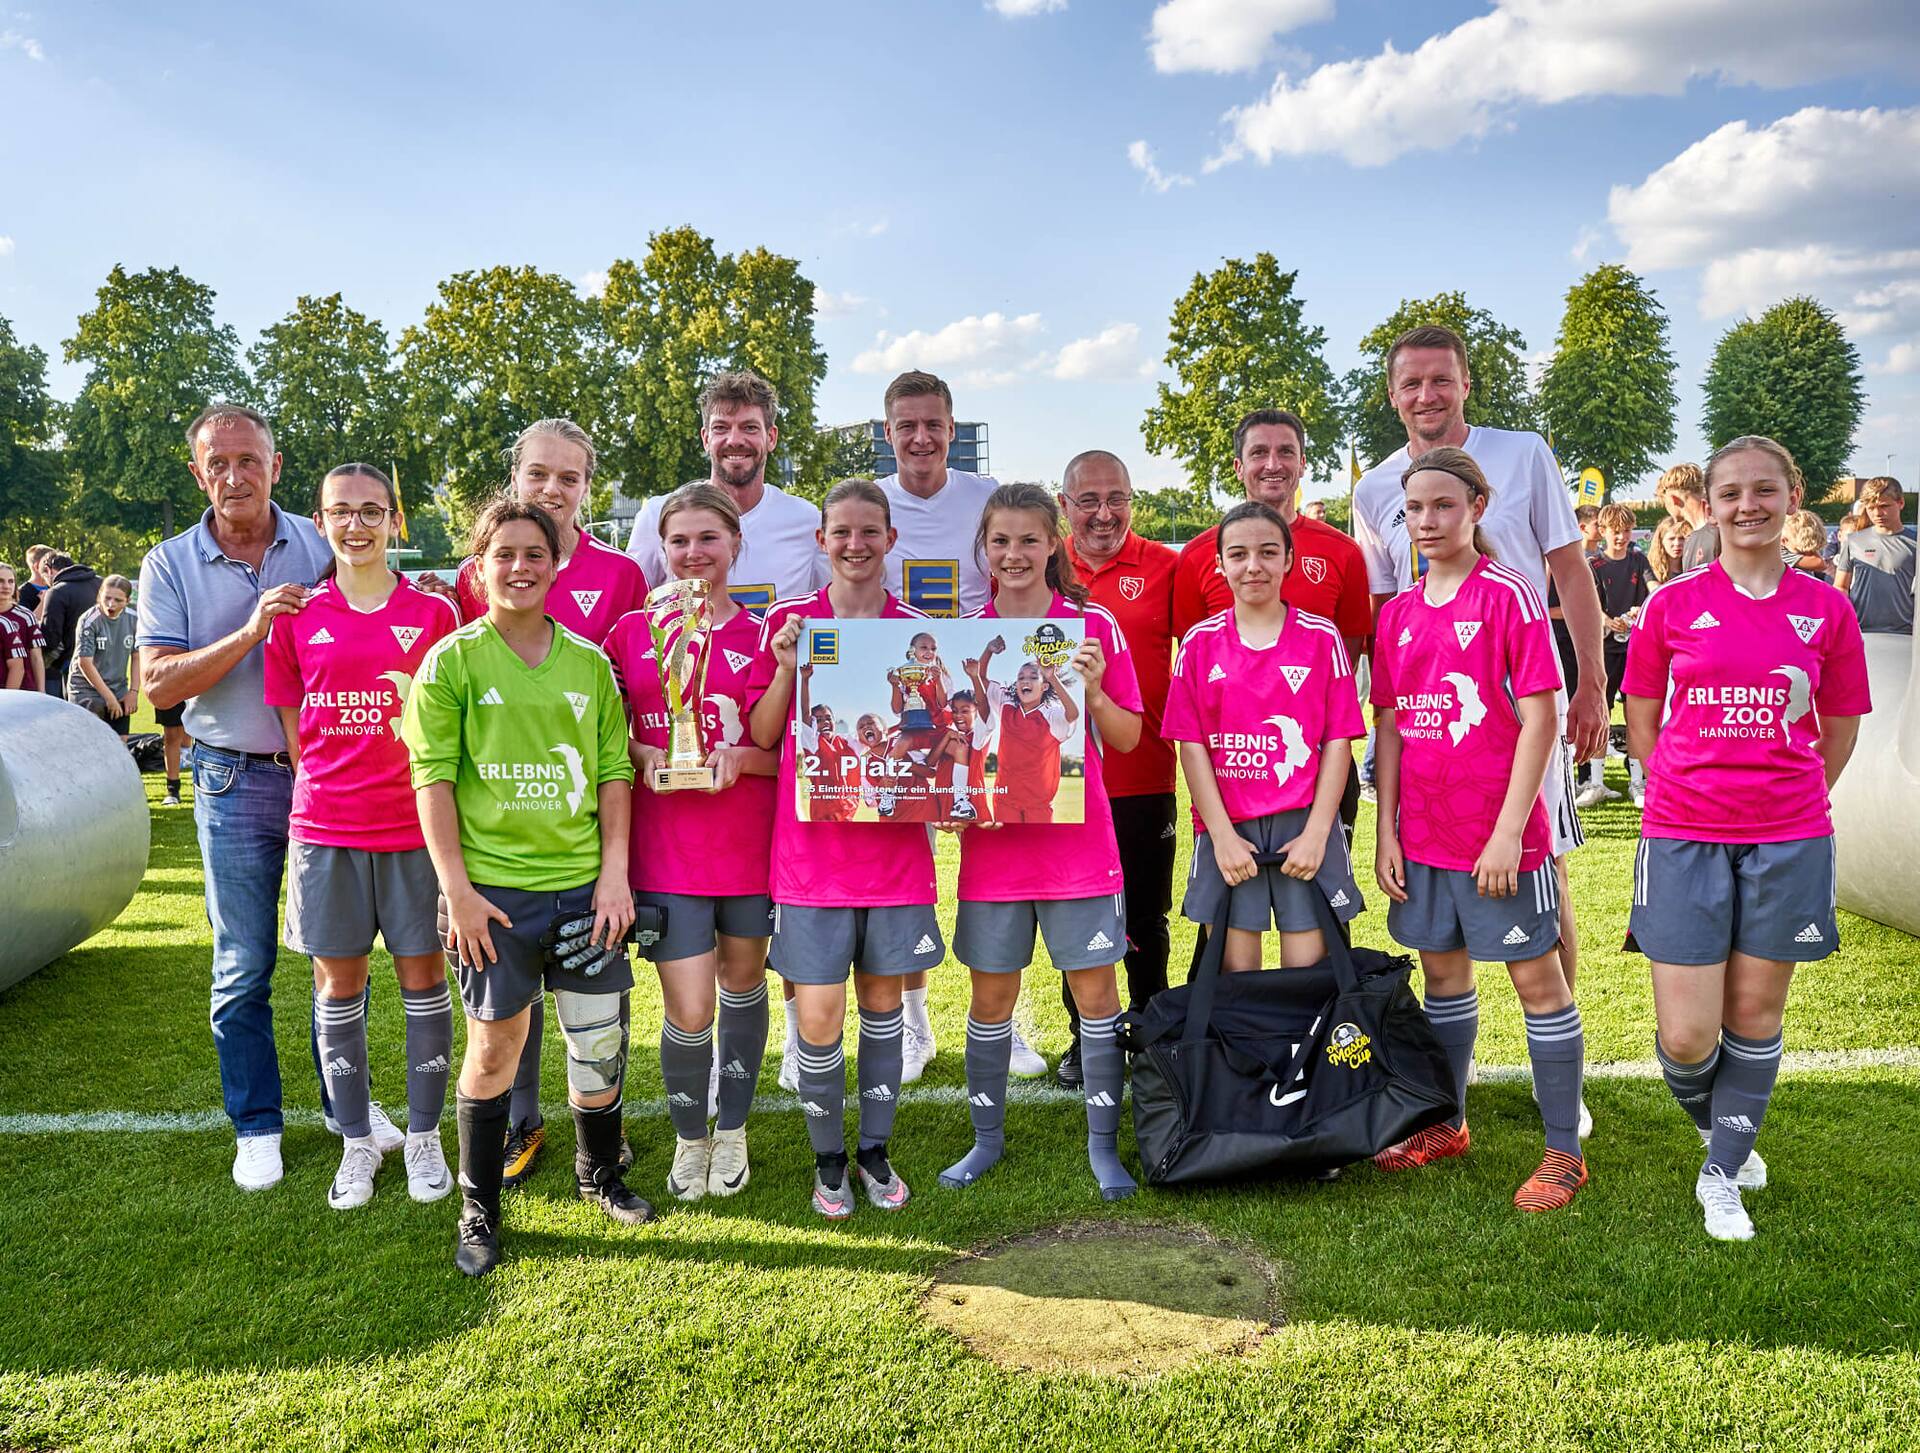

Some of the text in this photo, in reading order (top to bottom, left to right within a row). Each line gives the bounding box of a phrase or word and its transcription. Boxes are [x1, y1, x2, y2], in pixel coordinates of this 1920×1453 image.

[1584, 480, 1597, 495] E
[814, 633, 835, 654] E
[1022, 638, 1078, 656] Master
[1040, 654, 1070, 667] Cup
[308, 691, 393, 707] ERLEBNIS
[1395, 694, 1453, 710] RLEBNIS
[1688, 686, 1787, 706] ERLEBNIS
[340, 708, 382, 724] ZOO
[1414, 712, 1442, 727] ZOO
[1722, 707, 1774, 725] ZOO
[320, 726, 384, 736] HANNOVER
[1700, 728, 1776, 739] HANNOVER
[804, 756, 913, 777] 2. Platz
[1225, 751, 1267, 768] ZOO
[478, 763, 566, 780] ERLEBNIS
[515, 782, 559, 798] ZOO
[894, 784, 907, 793] für
[911, 785, 926, 793] ein
[929, 785, 1008, 795] Bundesligaspiel
[496, 800, 562, 810] HANNOVER
[1087, 941, 1114, 950] adidas
[1328, 1034, 1370, 1066] Master
[1349, 1048, 1371, 1069] Cup
